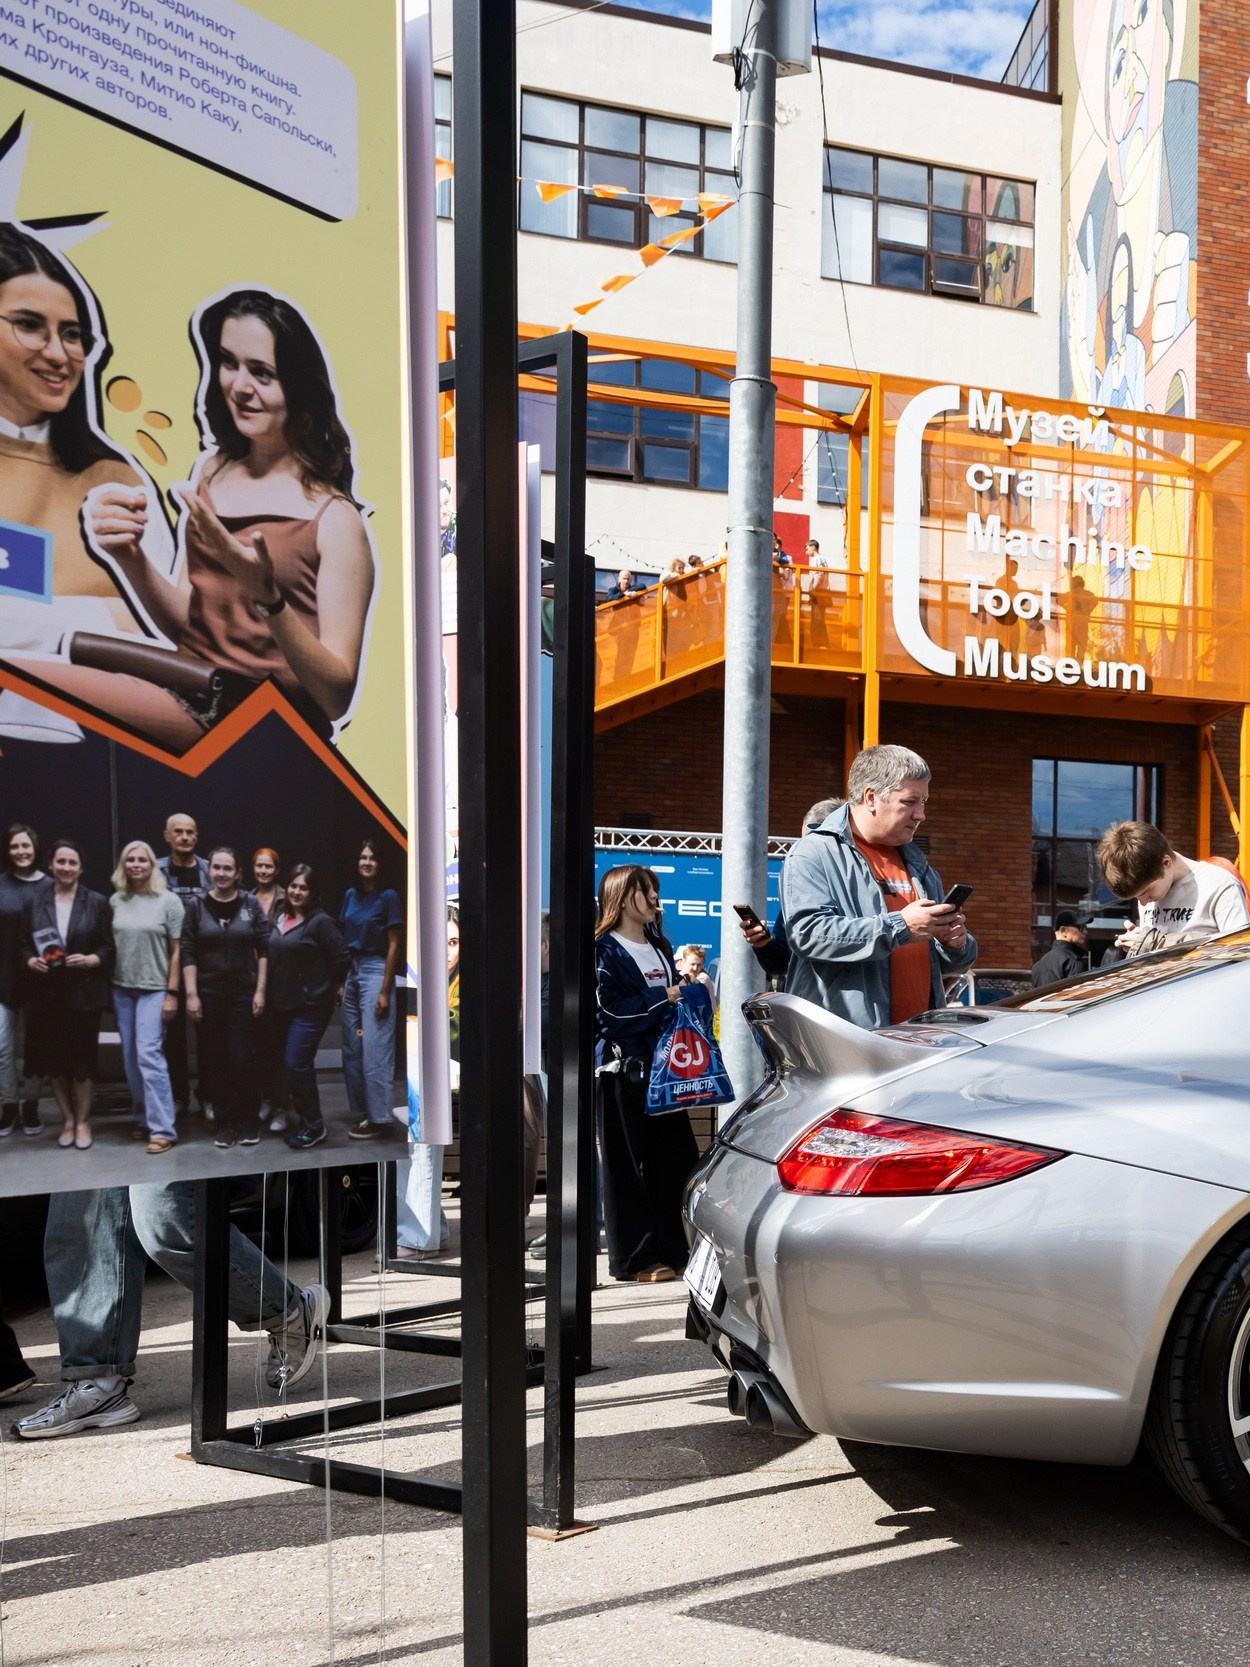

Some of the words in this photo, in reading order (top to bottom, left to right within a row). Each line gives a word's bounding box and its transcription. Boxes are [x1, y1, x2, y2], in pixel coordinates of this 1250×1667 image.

[156, 0, 236, 40] единяют
[32, 18, 134, 82] Кронгауза,
[141, 70, 196, 110] Митио
[201, 98, 242, 134] Каку,
[88, 3, 130, 34] одну
[136, 26, 247, 90] прочитанную
[251, 84, 296, 116] книгу.
[113, 0, 158, 26] уры,
[164, 18, 194, 42] или
[199, 36, 302, 98] нон-фикшна.
[24, 43, 90, 83] других
[95, 76, 172, 121] авторов.
[45, 4, 174, 76] произведения
[179, 66, 247, 113] Роберта
[251, 103, 337, 158] Сапольски,
[968, 388, 1110, 446] Музей
[966, 463, 1122, 508] станка
[966, 512, 1153, 571] Machine
[963, 573, 1053, 620] Tool
[964, 636, 1147, 692] Museum
[1163, 907, 1195, 922] TRUE
[670, 1040, 704, 1068] GJ
[673, 1079, 714, 1096] ЦЕННОСТЬ
